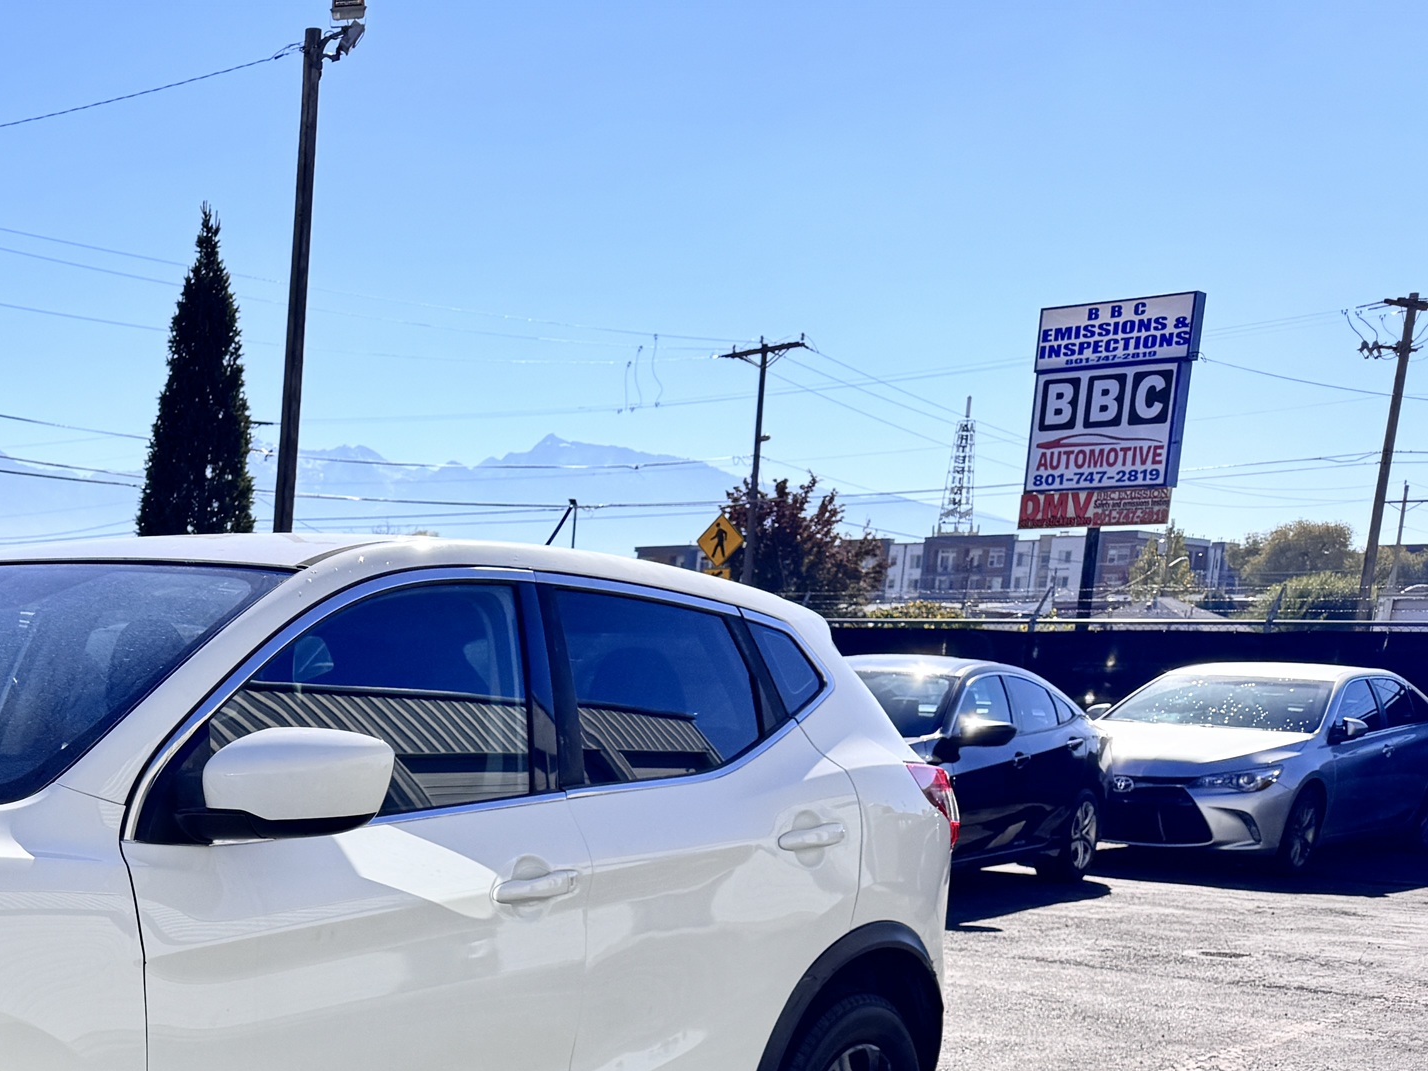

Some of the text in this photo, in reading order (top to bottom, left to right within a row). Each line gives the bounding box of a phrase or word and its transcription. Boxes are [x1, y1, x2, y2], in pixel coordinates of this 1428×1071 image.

[1087, 302, 1147, 321] B B C
[1041, 316, 1190, 343] EMISSIONS &
[1039, 330, 1190, 359] INSPECTIONS
[1065, 350, 1157, 365] 801-747-2819
[1044, 374, 1167, 427] BBC
[1036, 445, 1164, 471] AUTOMOTIVE
[1033, 469, 1160, 487] 801-747-2819
[1021, 491, 1095, 521] DMV
